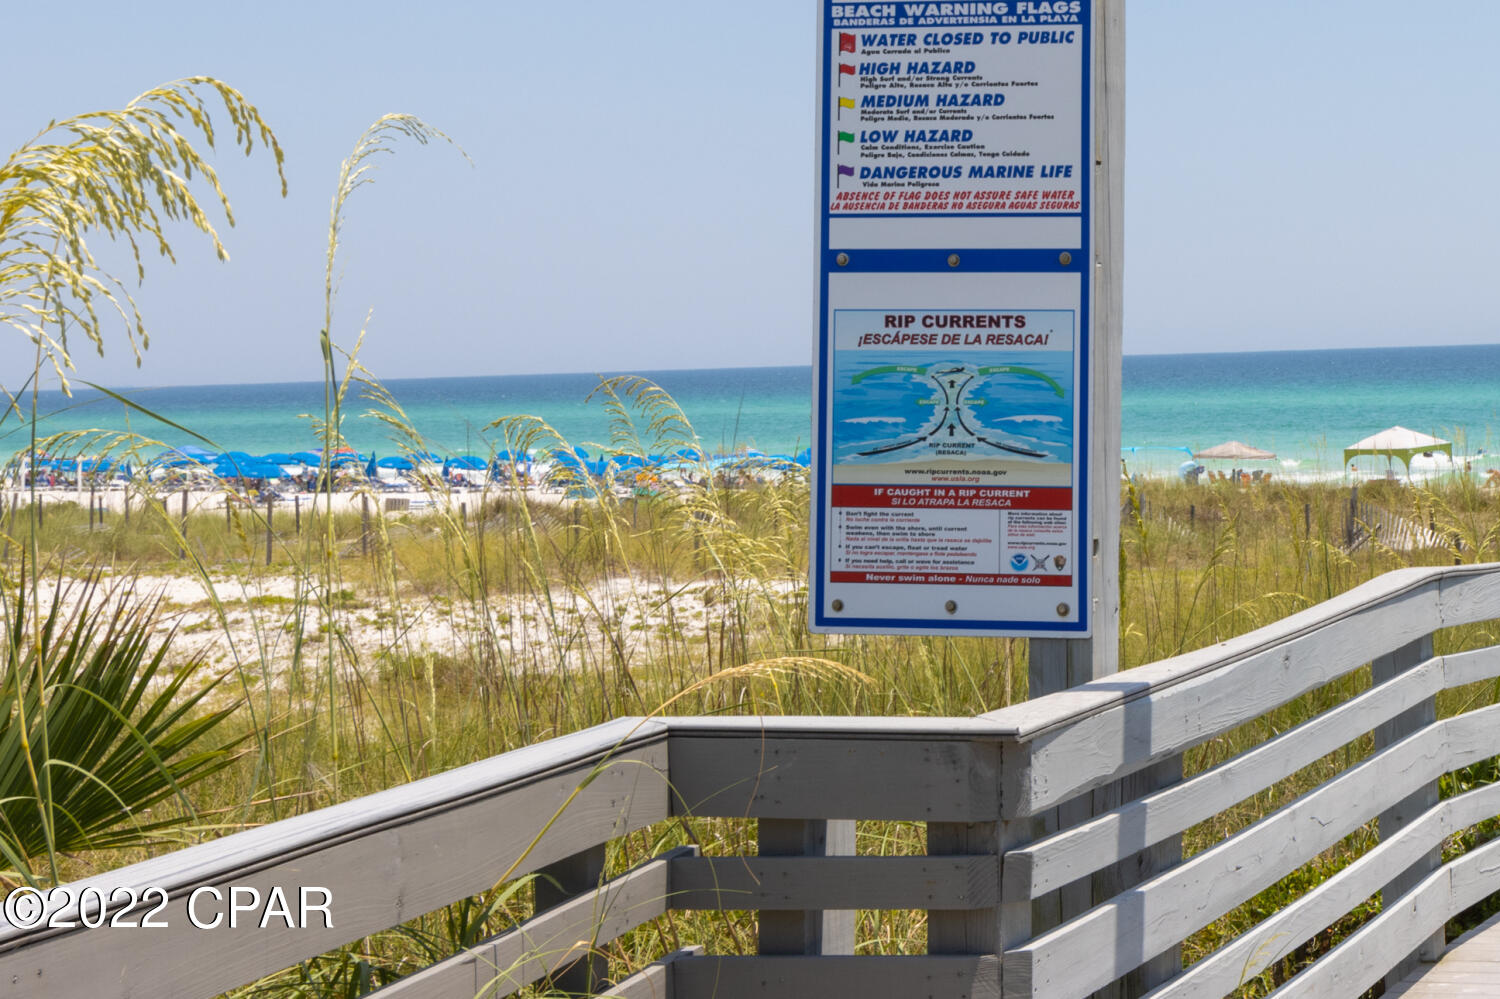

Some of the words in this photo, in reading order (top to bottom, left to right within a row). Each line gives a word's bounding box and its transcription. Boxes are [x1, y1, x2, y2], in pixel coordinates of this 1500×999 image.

[831, 4, 895, 17] BEACH
[903, 2, 1008, 16] WARNING
[1016, 0, 1081, 14] FLAGS
[833, 17, 895, 26] BANDERAS
[899, 17, 913, 25] DE
[917, 15, 997, 24] ADVERTENSIA
[1001, 15, 1017, 23] EN
[1039, 14, 1078, 22] PLAYA
[861, 33, 917, 46] WATER
[923, 32, 984, 45] CLOSED
[990, 31, 1011, 44] TO
[1017, 30, 1074, 44] PUBLIC
[858, 62, 901, 75] HIGH
[906, 61, 975, 74] HAZARD
[860, 94, 929, 107] MEDIUM
[935, 93, 1005, 106] HAZARD
[859, 130, 899, 143] LOW
[903, 129, 973, 142] HAZARD
[859, 165, 962, 179] DANGEROUS
[967, 165, 1034, 178] MARINE
[1040, 165, 1072, 177] LIFE
[836, 191, 880, 201] ABSENCE
[883, 191, 896, 200] OF
[898, 191, 921, 200] FLAG
[923, 191, 950, 200] DOES
[952, 190, 972, 200] NOT
[973, 190, 1012, 200] ASSURE
[1013, 190, 1038, 200] SAFE
[1041, 190, 1074, 200] WATER
[830, 202, 840, 210] LA
[842, 201, 885, 210] AUSENCIA
[887, 201, 899, 210] DE
[902, 201, 949, 210] BANDERAS
[951, 201, 963, 209] NO
[965, 201, 1006, 209] ASEGURA
[1007, 201, 1038, 209] AGUAS
[1039, 200, 1080, 209] SEGURAS
[884, 314, 915, 328] RIP
[921, 314, 1025, 328] CURRENTS
[857, 331, 938, 347] ¡ESCÁPESE
[940, 333, 961, 345] DE
[963, 333, 981, 345] LA
[985, 333, 1049, 345] RESACA!
[886, 488, 931, 497] CAUGHT
[933, 488, 945, 497] IN
[947, 489, 955, 497] A
[958, 489, 976, 498] RIP
[979, 489, 1030, 498] CURRENT
[891, 498, 901, 506] SI
[902, 497, 916, 505] LO
[917, 497, 955, 505] ATRAPA
[956, 498, 970, 506] LA
[971, 498, 1011, 506] RESACA
[866, 573, 896, 582] Never
[898, 574, 925, 583] swim
[927, 574, 956, 583] alone
[965, 575, 995, 584] Nunca
[996, 575, 1019, 584] nade
[1020, 576, 1041, 585] solo
